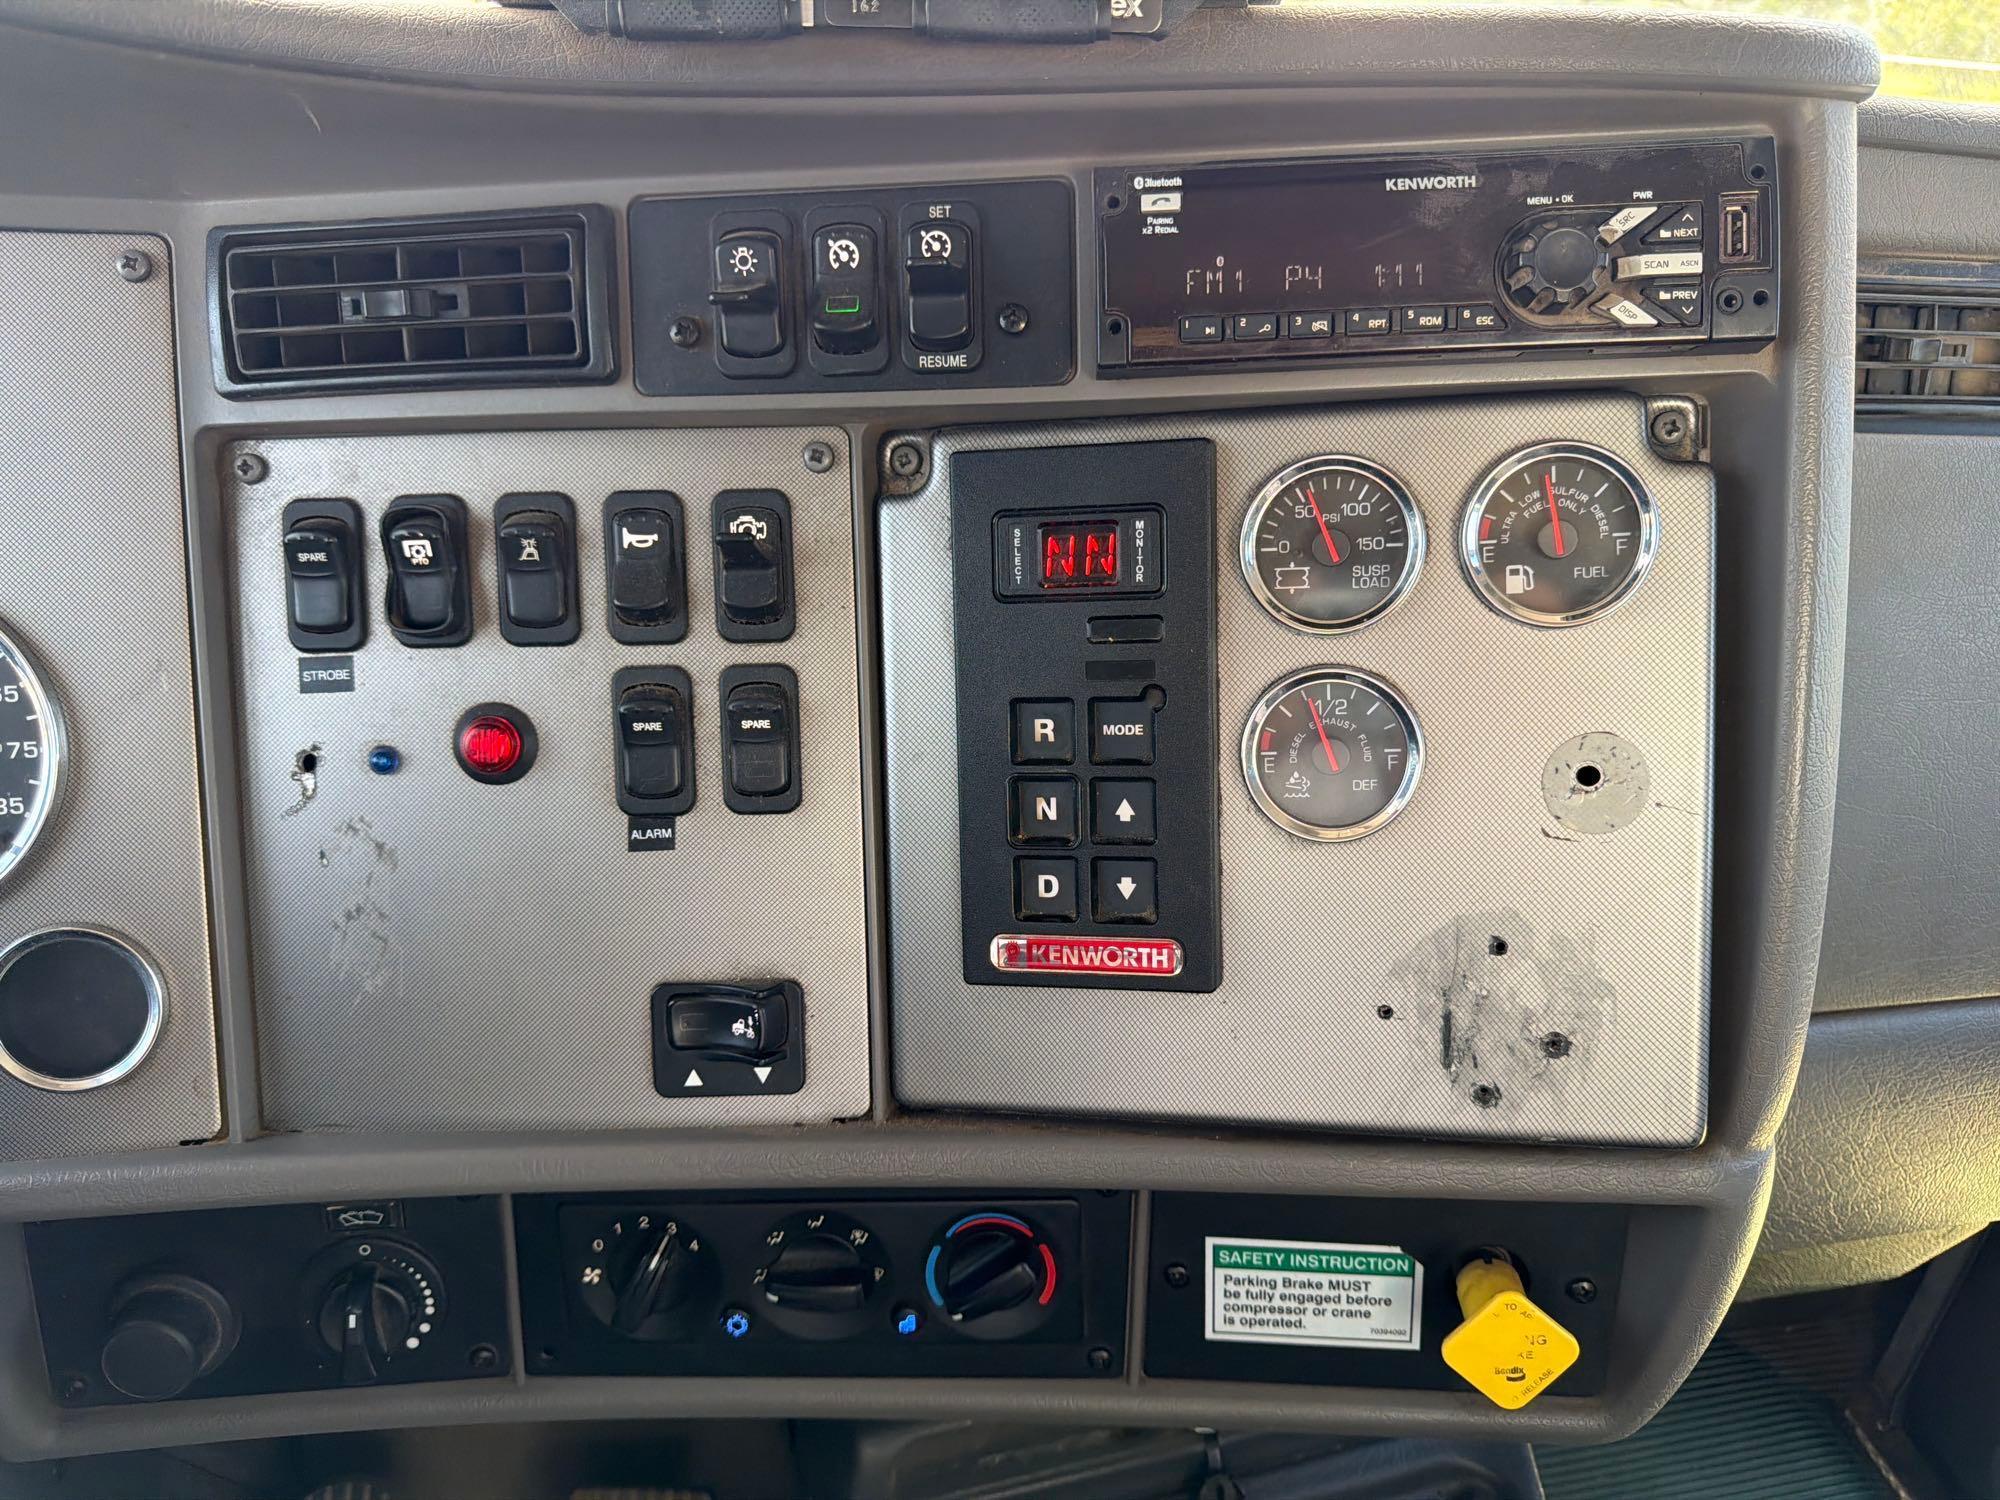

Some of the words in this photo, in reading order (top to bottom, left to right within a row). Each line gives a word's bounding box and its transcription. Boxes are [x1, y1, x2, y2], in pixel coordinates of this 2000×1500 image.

[1145, 176, 1183, 188] Bluetooth
[1385, 175, 1477, 191] KENWORTH
[1527, 196, 1553, 206] MENU
[1561, 194, 1574, 203] OK
[1632, 190, 1654, 200] PWR
[928, 205, 952, 219] SET
[1618, 210, 1636, 230] SRC
[1142, 226, 1153, 235] x2
[1673, 227, 1699, 237] NEXT
[1644, 260, 1670, 270] SCAN
[1680, 259, 1699, 267] ASCN
[1285, 264, 1323, 291] P4
[1374, 261, 1424, 288] 1:11
[1671, 290, 1698, 300] PREV
[1295, 316, 1302, 326] 3
[1352, 312, 1360, 322] 4
[1368, 318, 1387, 329] RPT
[1407, 310, 1415, 319] 5
[1419, 315, 1442, 326] RDM
[1463, 309, 1471, 319] 6
[1476, 315, 1495, 326] ESC
[1617, 304, 1639, 321] DISP
[1239, 317, 1247, 327] 2
[919, 354, 968, 368] RESUME
[1294, 504, 1317, 519] 50
[1340, 502, 1372, 517] 100
[1500, 510, 1518, 544] ULTRA
[1518, 489, 1541, 508] LOW
[1550, 486, 1590, 503] SULFUR
[1590, 504, 1610, 540] DIESEL
[1522, 500, 1552, 519] FUEL
[1557, 498, 1587, 515] ONLY
[1322, 513, 1341, 524] PSI
[1134, 520, 1146, 583] MONITOR
[1278, 539, 1291, 554] 0
[1355, 536, 1386, 551] 150
[1482, 545, 1495, 563] E
[1616, 538, 1629, 556] F
[297, 552, 328, 563] SPARE
[410, 557, 430, 566] PTO
[1013, 528, 1022, 585] SELECT
[1352, 564, 1391, 577] SUSP
[1573, 565, 1610, 579] FUEL
[1352, 576, 1391, 589] LOAD
[302, 669, 351, 682] STROBE
[1314, 698, 1348, 717] 1/2
[632, 722, 664, 732] SPARE
[741, 719, 772, 729] SPARE
[1033, 718, 1056, 743] R
[1102, 724, 1144, 736] MODE
[6, 740, 39, 759] 75
[1289, 732, 1307, 764] DIESEL
[1358, 734, 1373, 763] FLUID
[1264, 756, 1275, 773] E
[1387, 754, 1399, 771] F
[1352, 779, 1379, 791] DEF
[1036, 796, 1058, 821] N
[630, 827, 673, 840] ALARM
[1037, 874, 1060, 898] D
[1031, 943, 1169, 969] KENWORTH
[592, 1238, 604, 1253] 0
[613, 1222, 622, 1235] 1
[639, 1215, 650, 1230] 2
[666, 1221, 678, 1236] 3
[688, 1239, 700, 1252] 4
[1218, 1249, 1286, 1267] SAFETY
[1289, 1253, 1410, 1272] INSTRUCTION
[1223, 1273, 1278, 1290] Parking
[1282, 1276, 1324, 1291] Brake
[1327, 1279, 1372, 1293] MUST
[1223, 1287, 1241, 1299] be
[1245, 1289, 1275, 1303] fully
[1279, 1292, 1342, 1306] engaged
[1346, 1293, 1393, 1308] before
[1223, 1302, 1308, 1317] compressor
[1312, 1306, 1328, 1317] or
[1331, 1307, 1372, 1319] crane
[1504, 1303, 1518, 1311] TO
[1223, 1313, 1236, 1326] is
[1239, 1315, 1307, 1330] operated.
